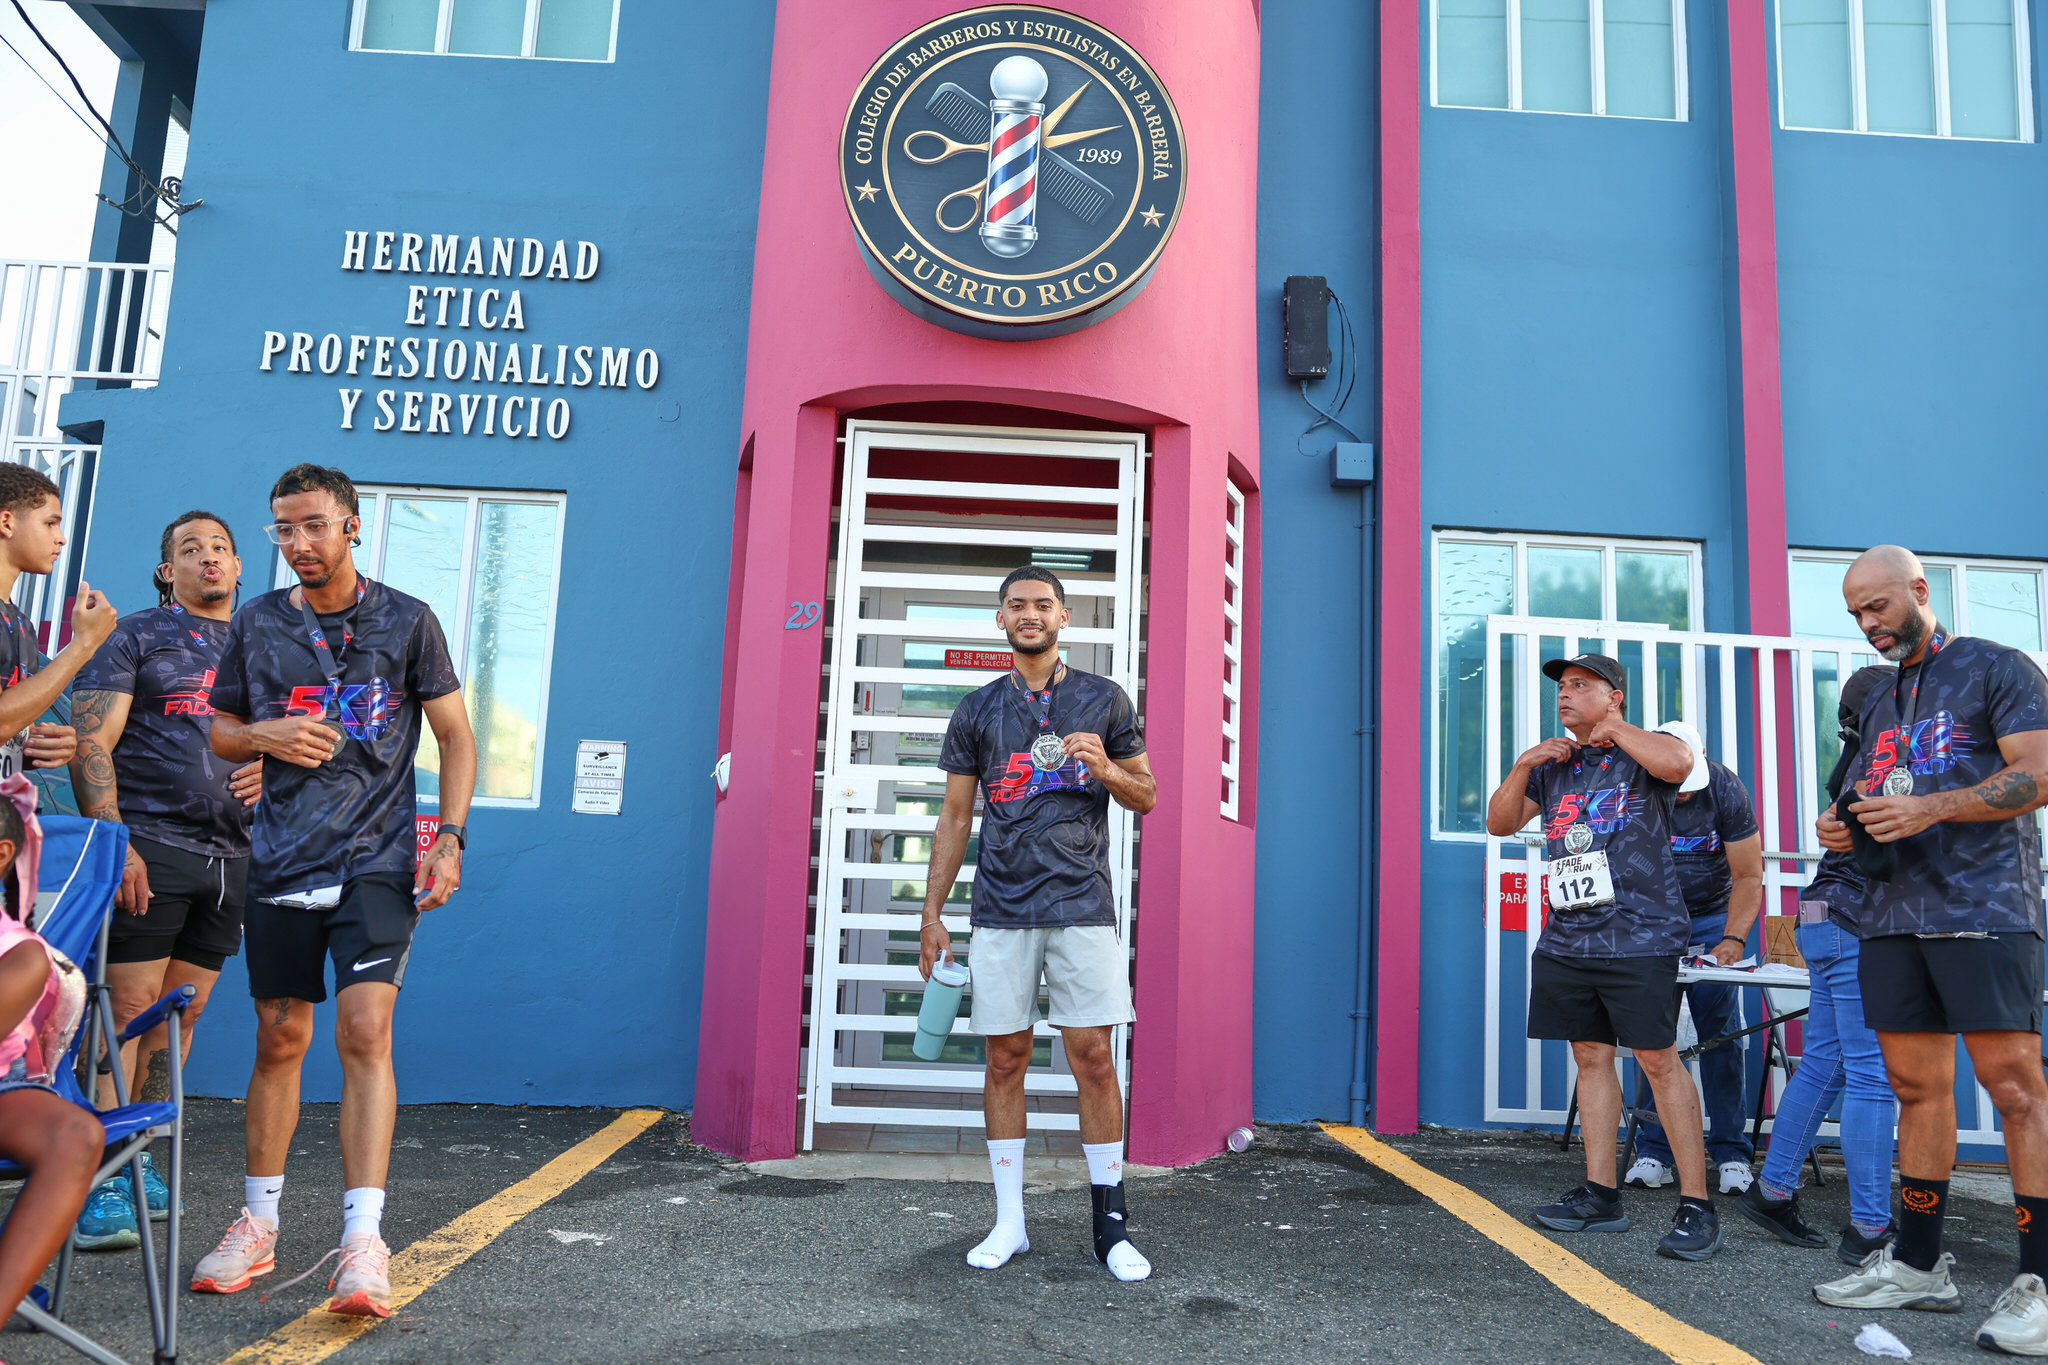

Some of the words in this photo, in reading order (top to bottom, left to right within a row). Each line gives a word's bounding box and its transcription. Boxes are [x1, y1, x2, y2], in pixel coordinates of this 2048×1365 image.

[855, 85, 892, 164] COLEGIO
[884, 63, 908, 88] DE
[906, 21, 1002, 68] BARBEROS
[1005, 20, 1019, 35] Y
[1022, 21, 1121, 71] ESTILISTAS
[1115, 65, 1142, 91] EN
[1134, 90, 1173, 181] BARBERÍA
[1076, 147, 1122, 166] 1989
[341, 230, 600, 280] HERMANDAD
[892, 242, 1027, 308] PUERTO
[1036, 261, 1118, 307] RICO
[404, 285, 525, 330] ETICA
[259, 331, 660, 389] PROFESIONALISMO
[338, 388, 363, 429] Y
[373, 389, 571, 439] SERVICIO
[784, 601, 822, 630] 29
[963, 652, 973, 660] SE
[976, 653, 1011, 661] PERMITEN
[581, 779, 616, 788] AVISO
[989, 786, 1028, 803] FADE
[1587, 818, 1625, 834] RUN
[1561, 856, 1583, 868] FADE
[1573, 863, 1592, 873] RUN
[1500, 892, 1528, 904] PARA
[1559, 877, 1597, 901] 112
